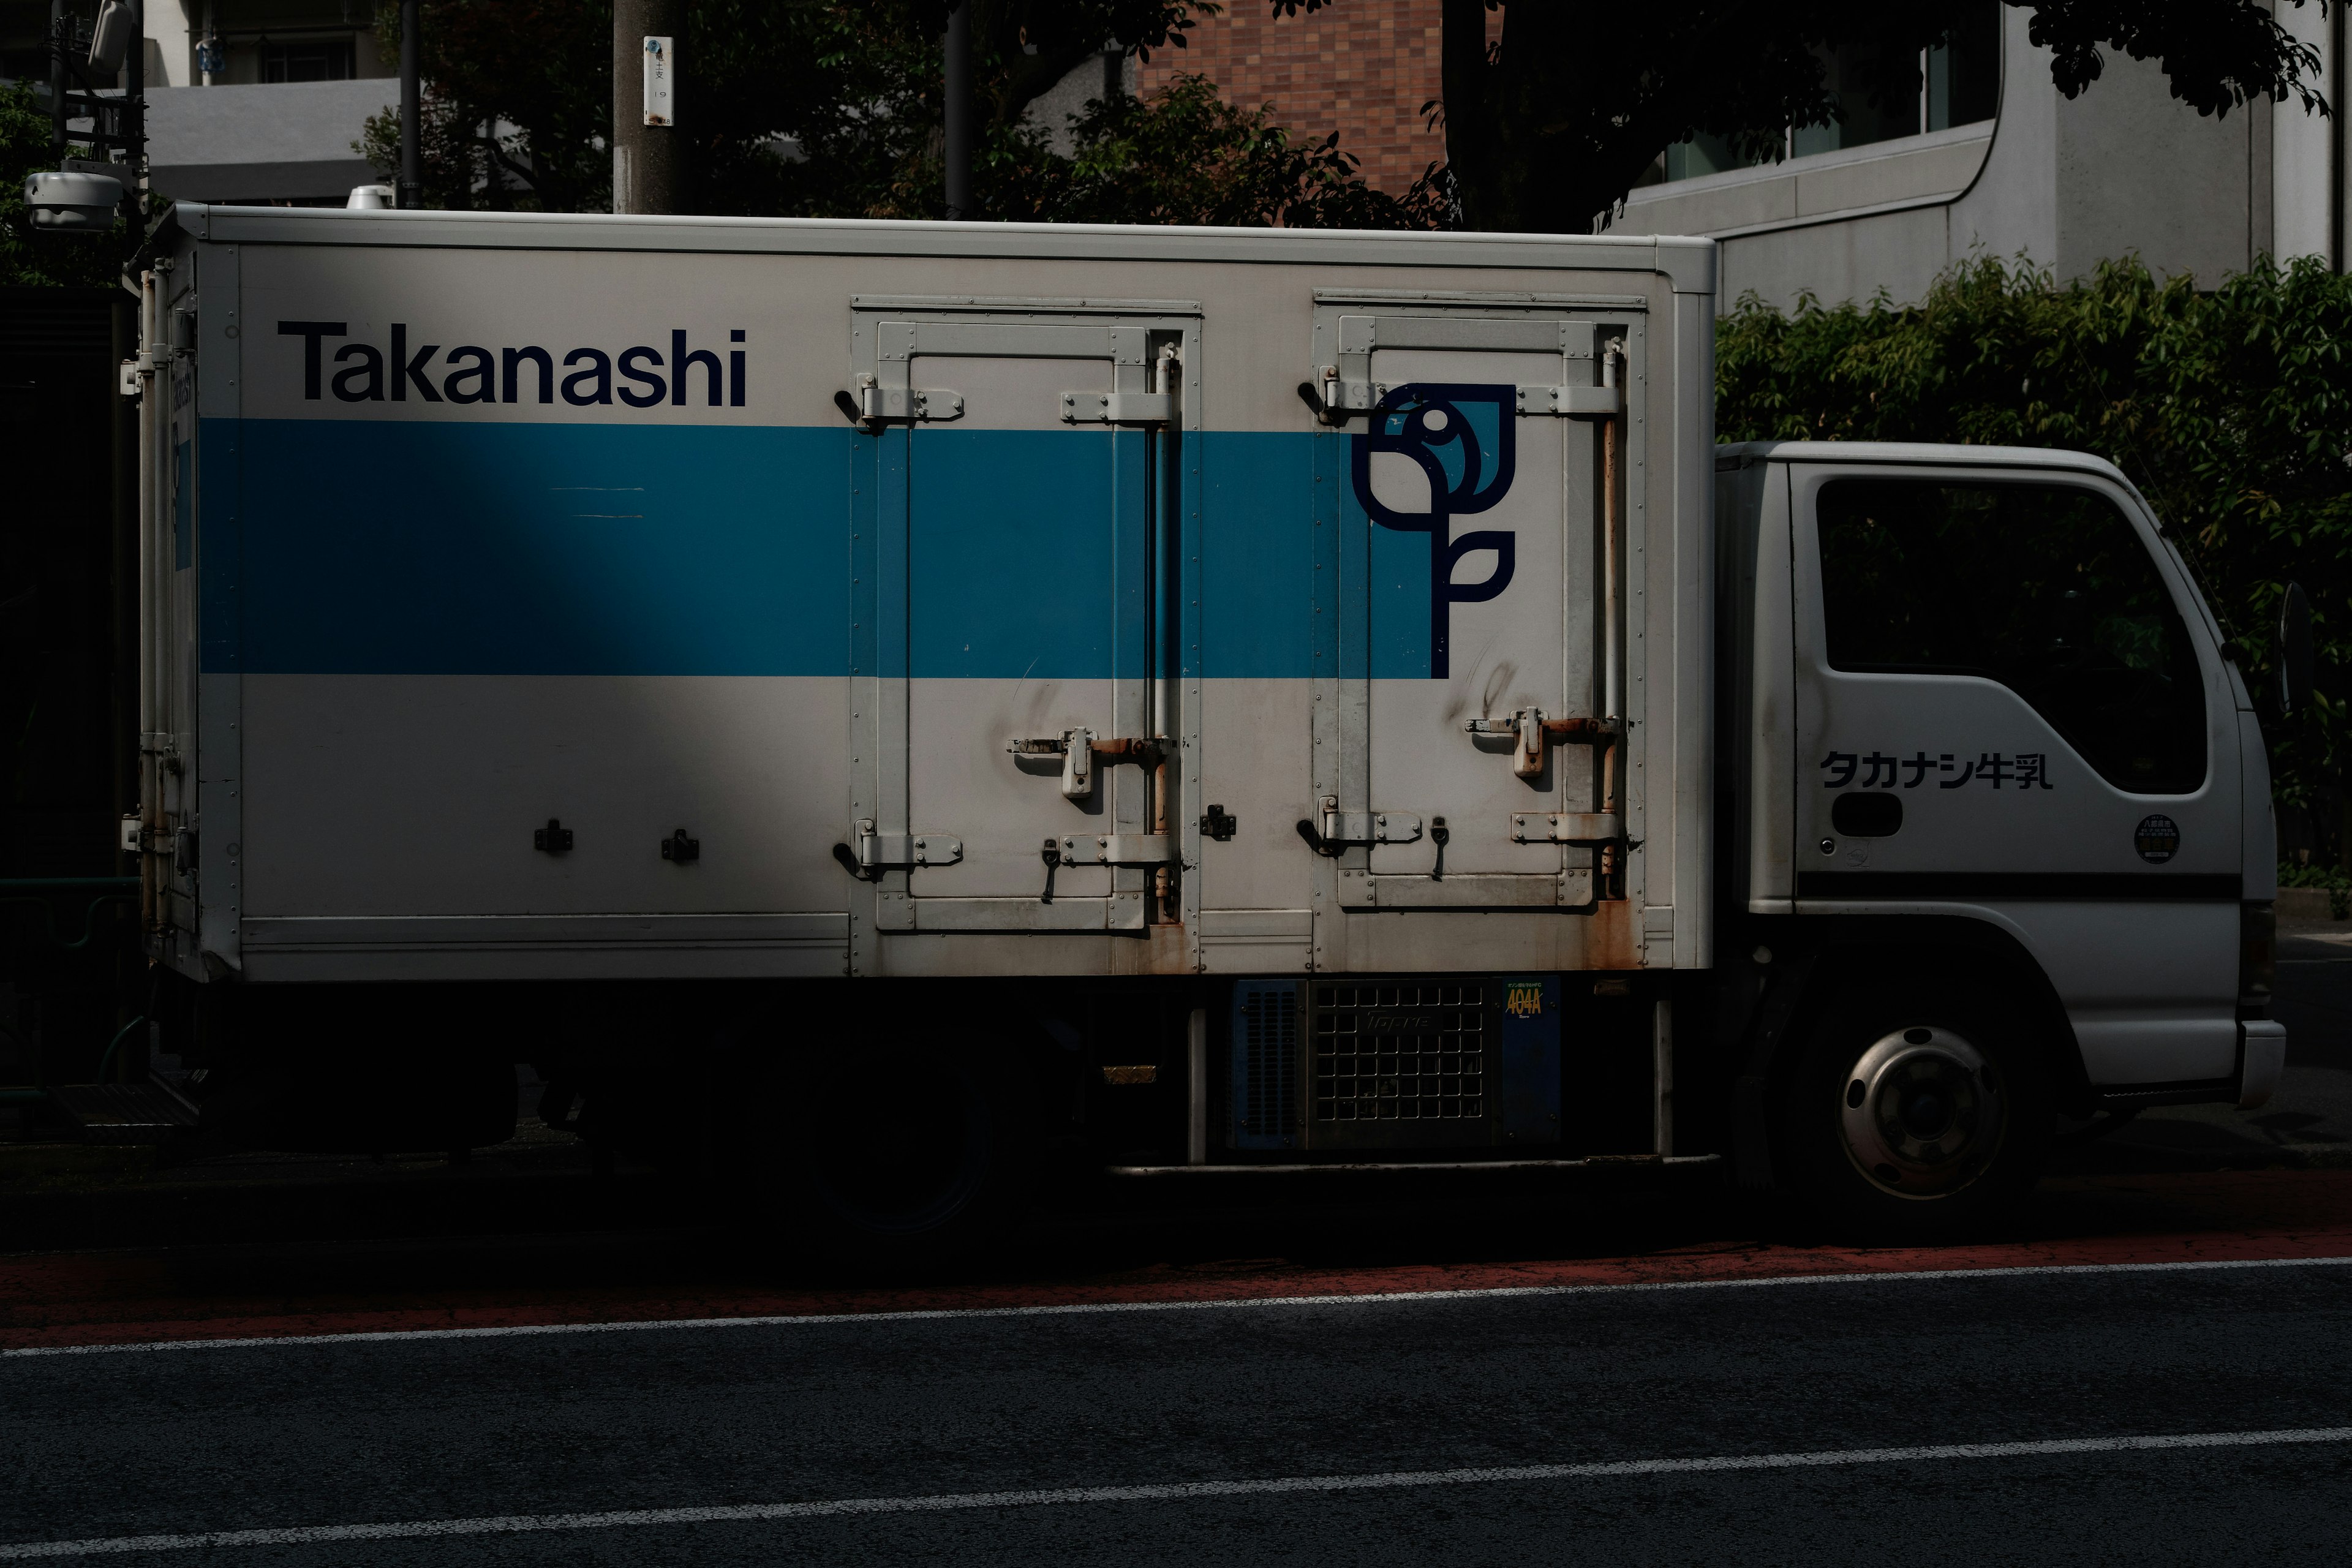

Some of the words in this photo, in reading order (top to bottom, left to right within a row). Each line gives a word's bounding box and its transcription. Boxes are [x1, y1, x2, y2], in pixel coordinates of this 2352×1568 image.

[277, 321, 745, 408] Takanashi
[1820, 752, 2053, 790] タカナシ牛乳
[1507, 988, 1542, 1014] 404A
[1367, 1011, 1431, 1033] Topre
